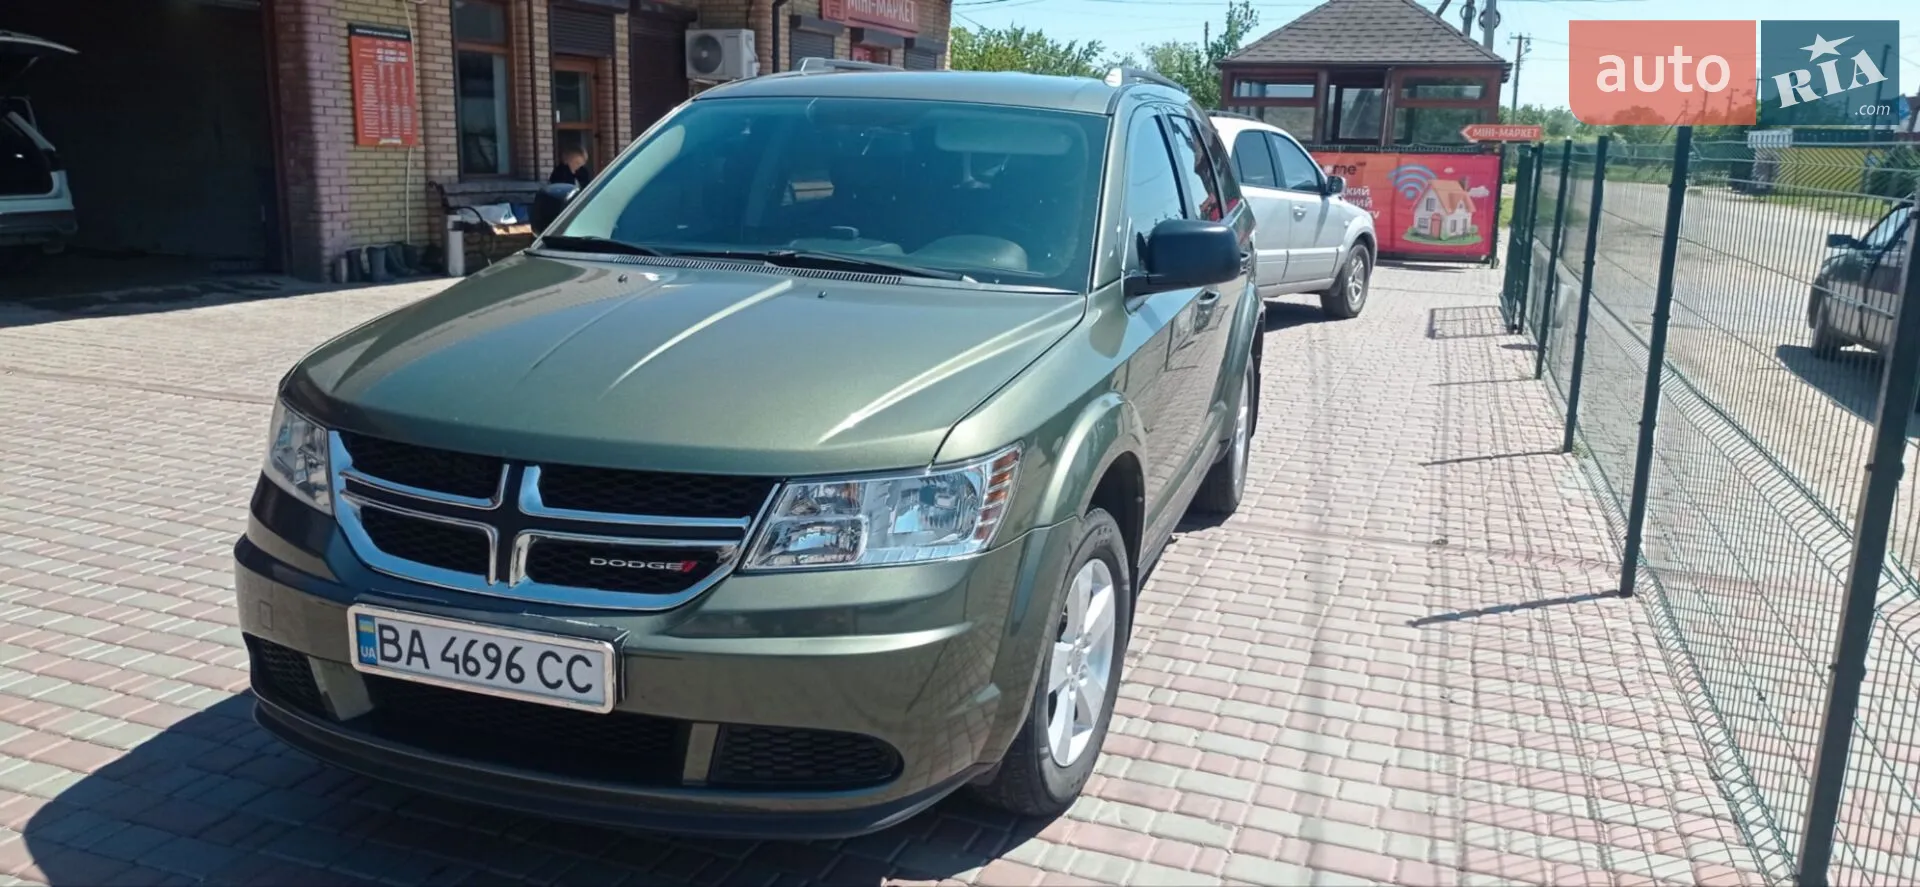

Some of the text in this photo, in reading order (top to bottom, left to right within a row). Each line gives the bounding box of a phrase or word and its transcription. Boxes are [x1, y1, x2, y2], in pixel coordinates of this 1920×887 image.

[1473, 127, 1538, 138] МІНІ-МАРКЕТ
[590, 557, 683, 571] DODGE
[360, 646, 377, 660] UA
[378, 624, 593, 694] BA 4696 CC
